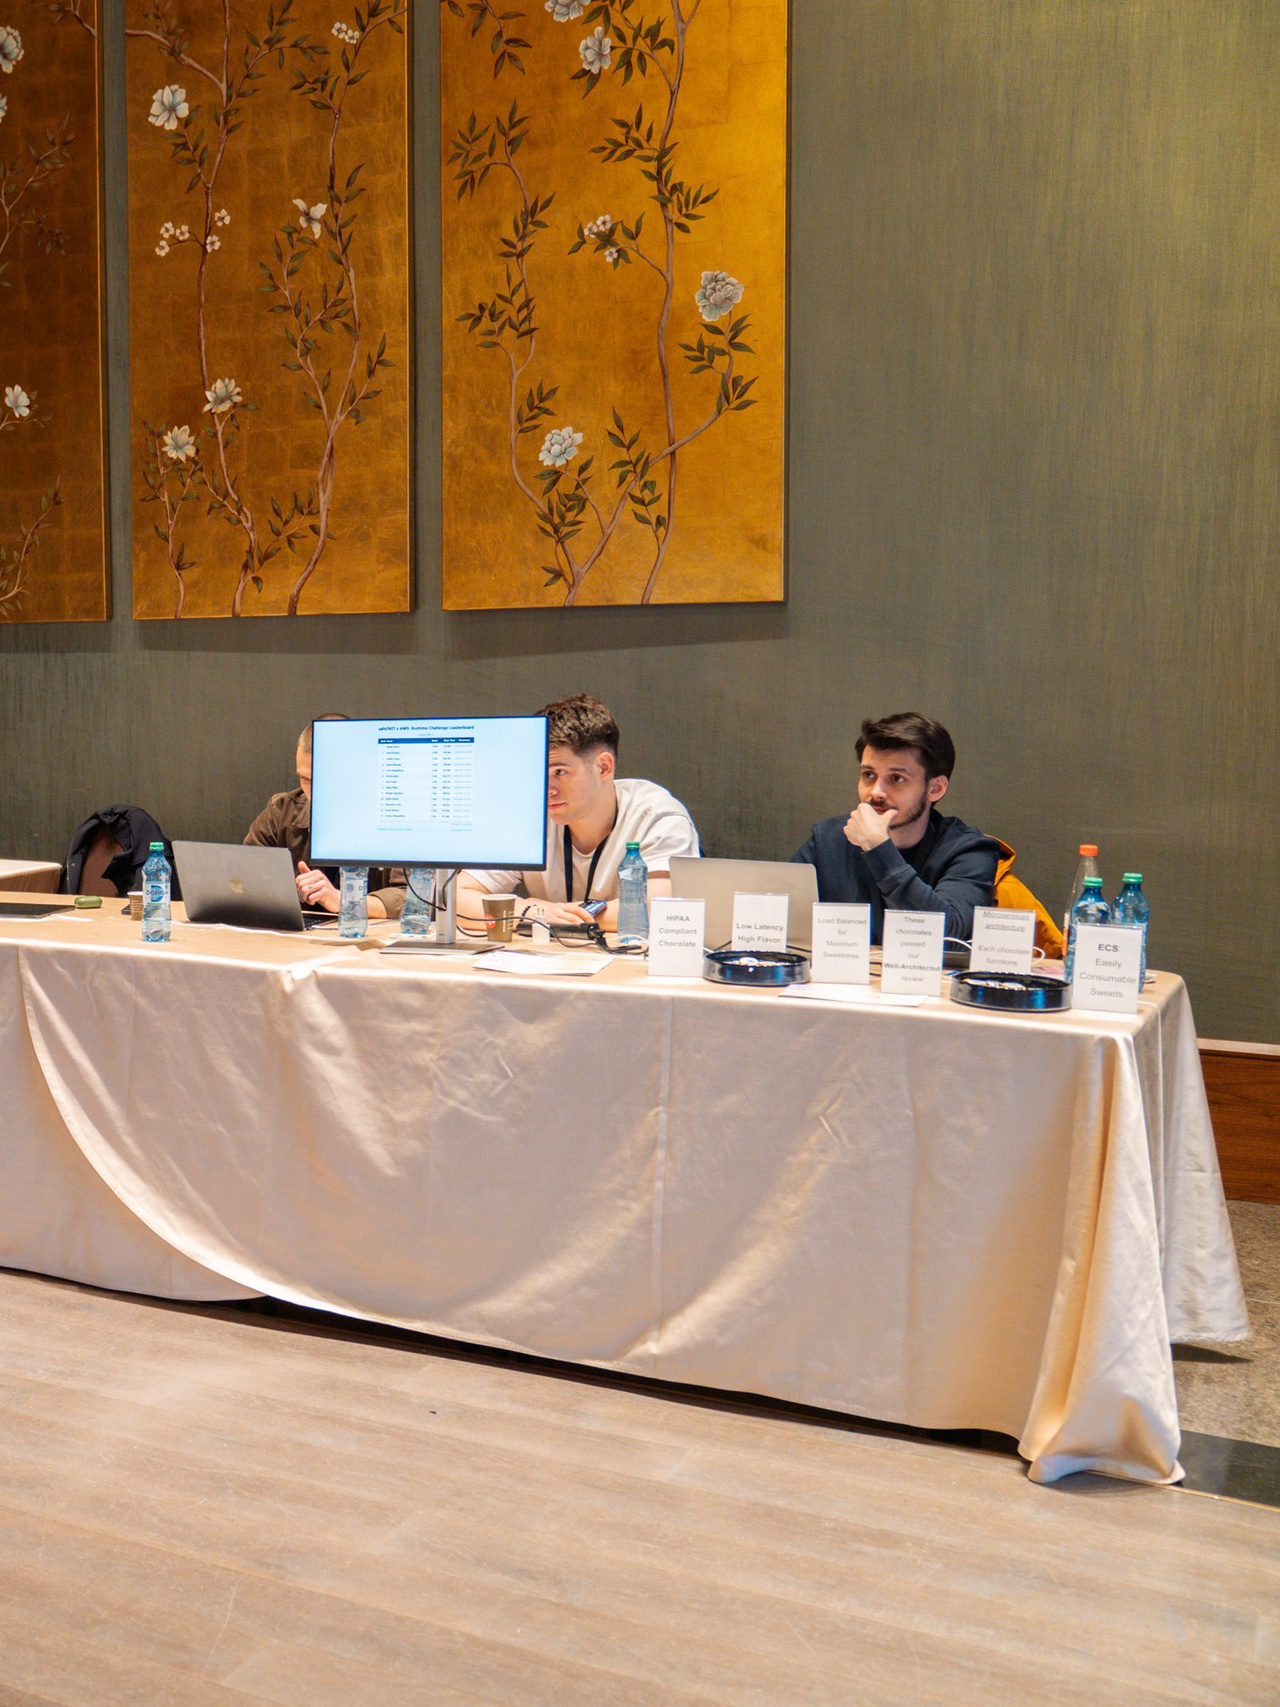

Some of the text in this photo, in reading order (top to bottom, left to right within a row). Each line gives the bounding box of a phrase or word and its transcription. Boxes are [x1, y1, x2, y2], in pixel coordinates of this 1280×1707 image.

[836, 917, 867, 925] Balanced
[904, 916, 926, 924] These
[658, 927, 697, 935] Compliant
[895, 928, 933, 936] chocolates
[658, 940, 697, 948] Chocolate
[738, 936, 756, 944] High
[884, 962, 941, 971] Well-Architected
[1095, 958, 1123, 969] Easily
[1079, 971, 1137, 984] Consumable
[1089, 987, 1124, 998] Sweets
